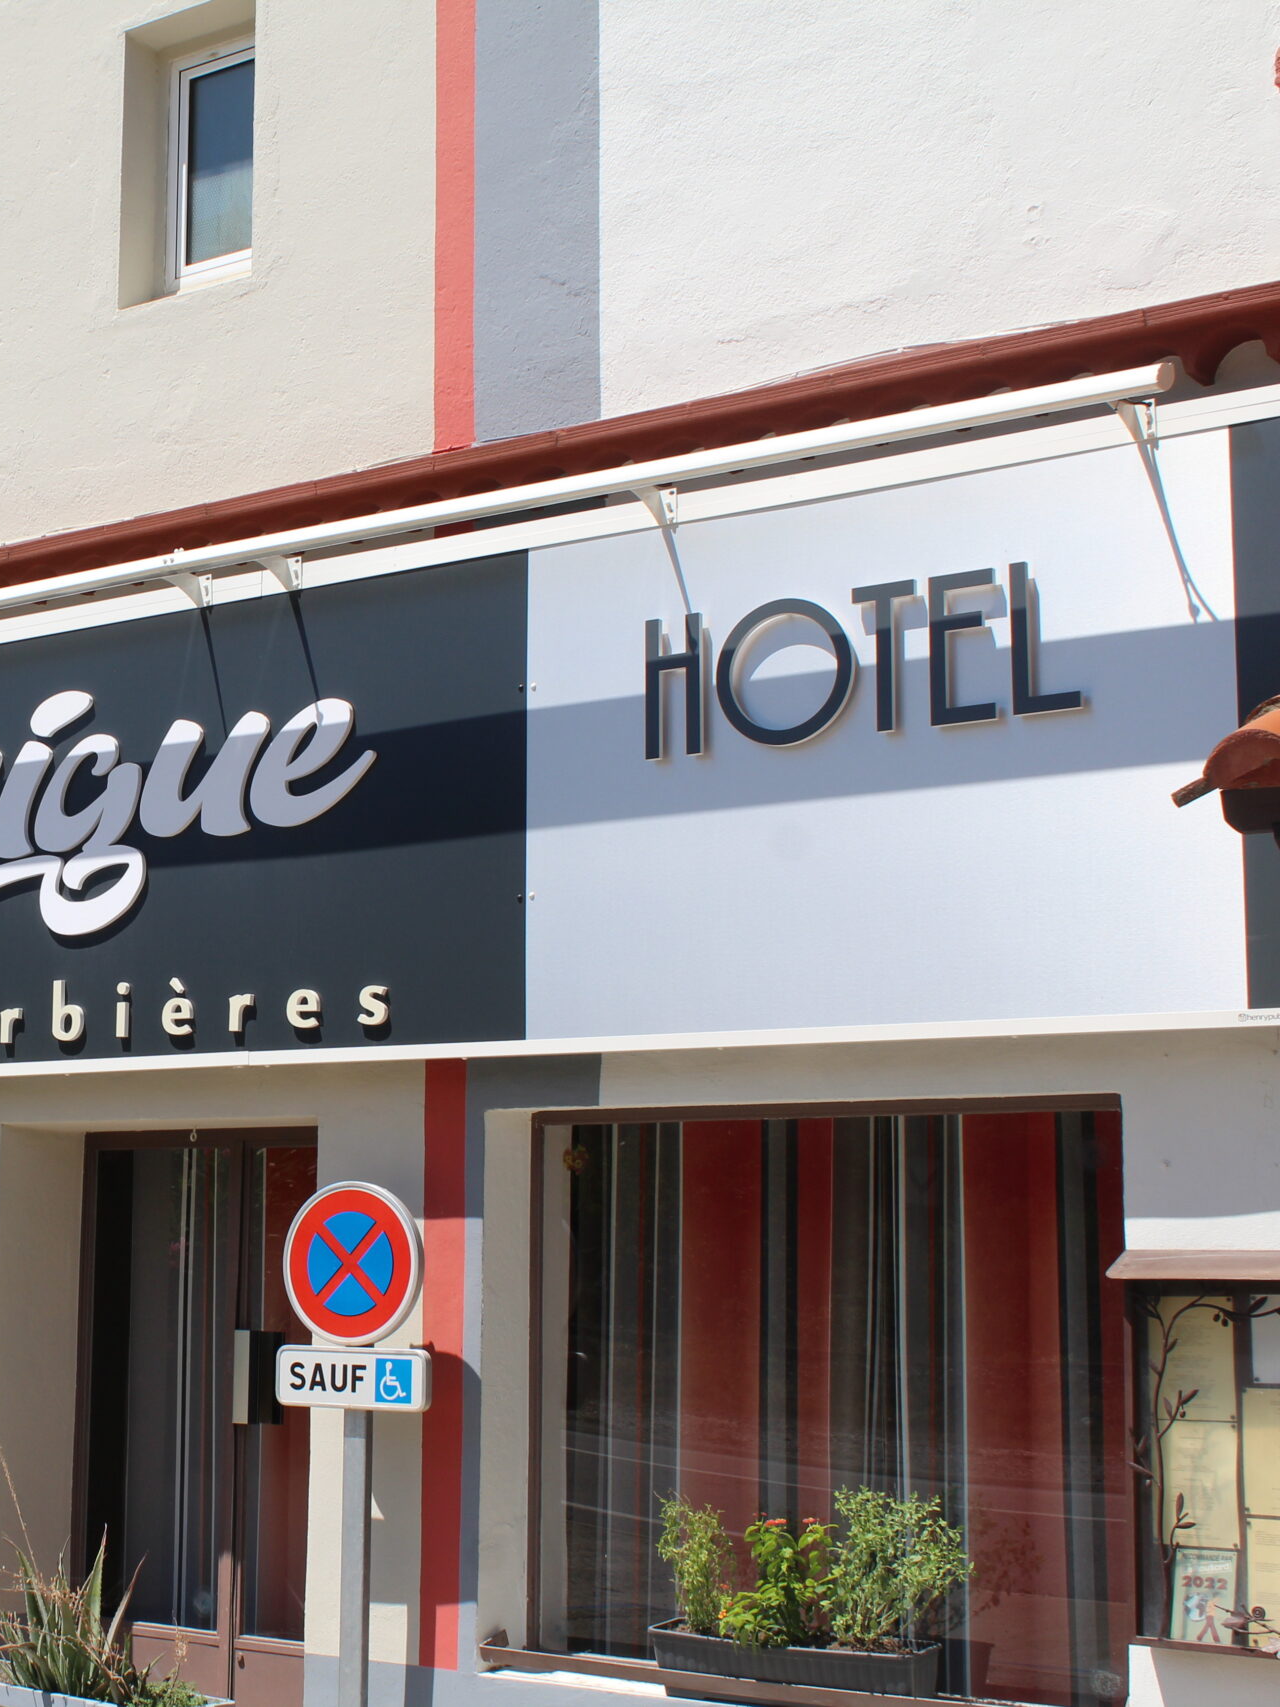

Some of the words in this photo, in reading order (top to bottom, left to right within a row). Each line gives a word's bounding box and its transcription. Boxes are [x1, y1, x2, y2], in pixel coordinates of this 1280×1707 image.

[645, 561, 1084, 760] HOTEL
[289, 1362, 367, 1393] SAUF
[1182, 1575, 1228, 1590] 2022
